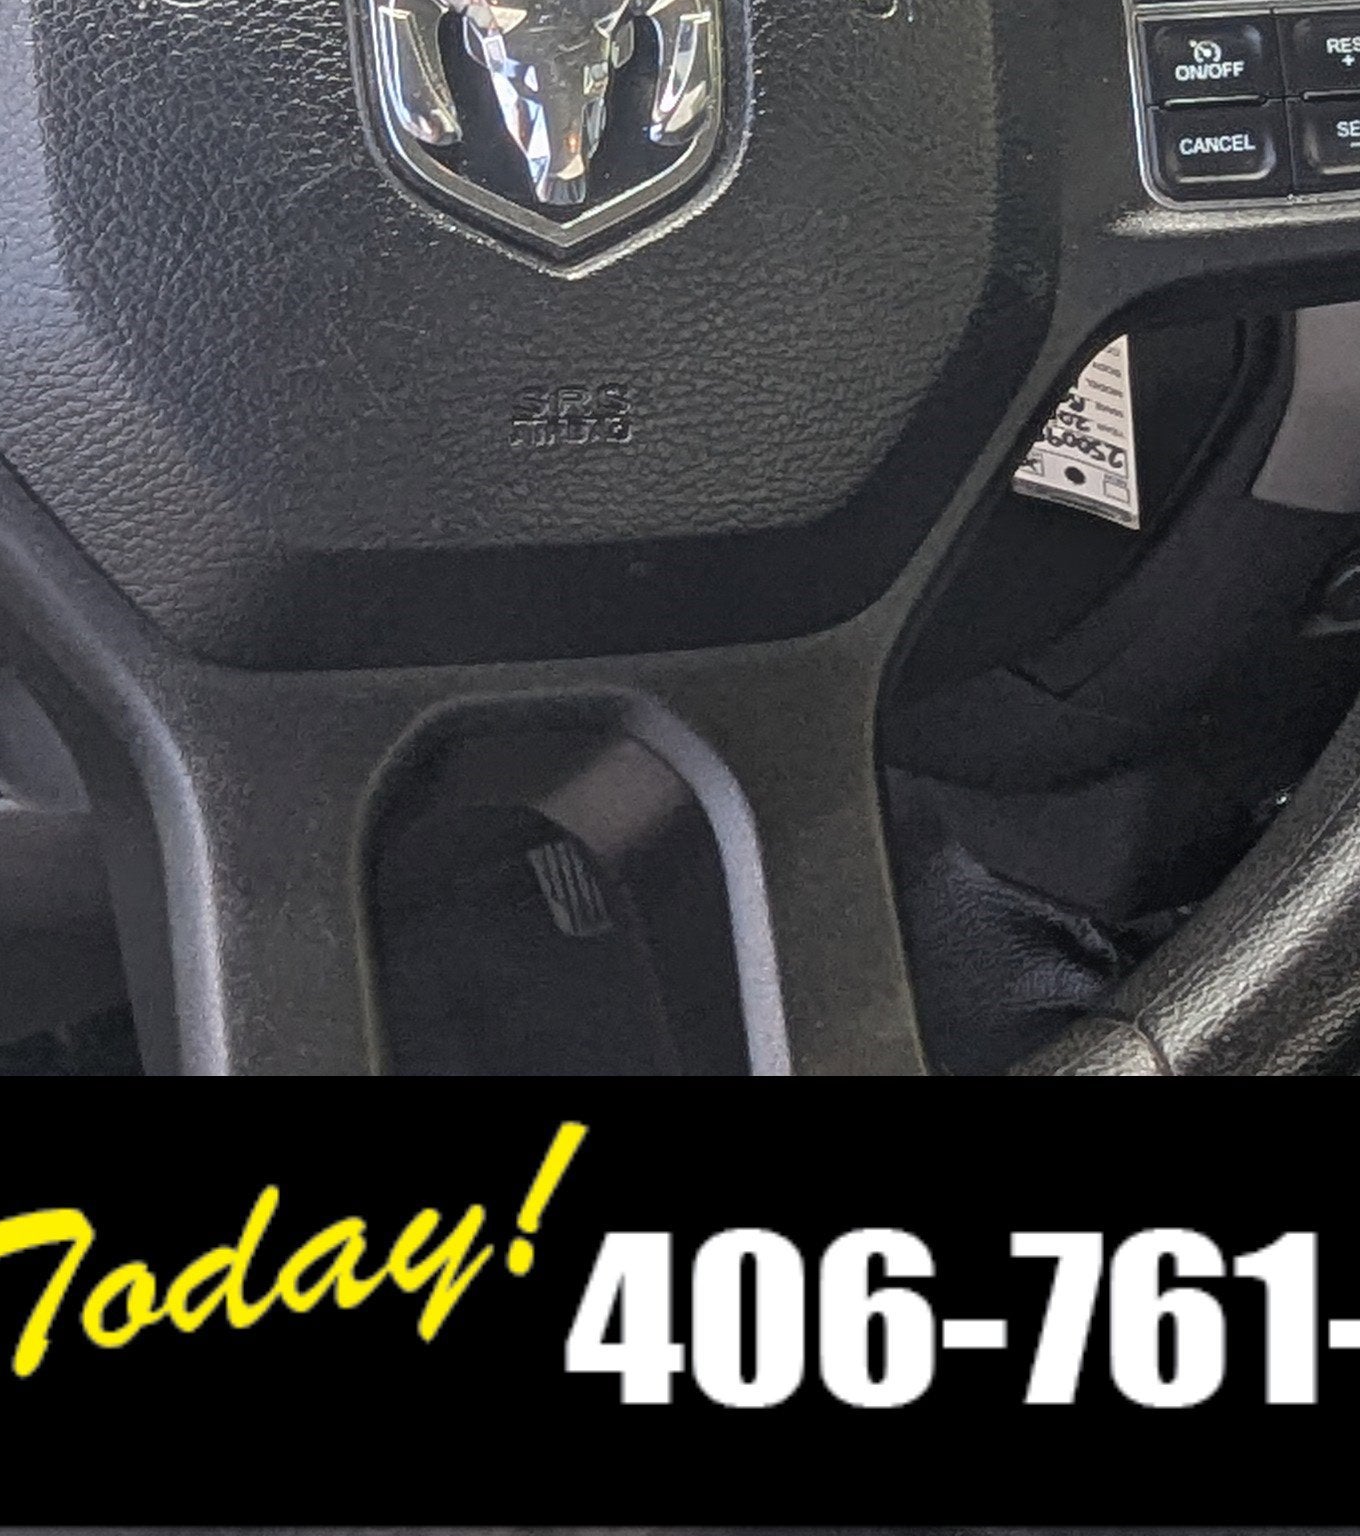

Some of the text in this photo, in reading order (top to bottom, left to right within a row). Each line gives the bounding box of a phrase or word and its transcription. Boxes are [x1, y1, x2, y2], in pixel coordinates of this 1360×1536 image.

[1175, 60, 1245, 82] ON/OFF
[1179, 133, 1256, 155] CANCEL
[513, 383, 632, 418] SRS
